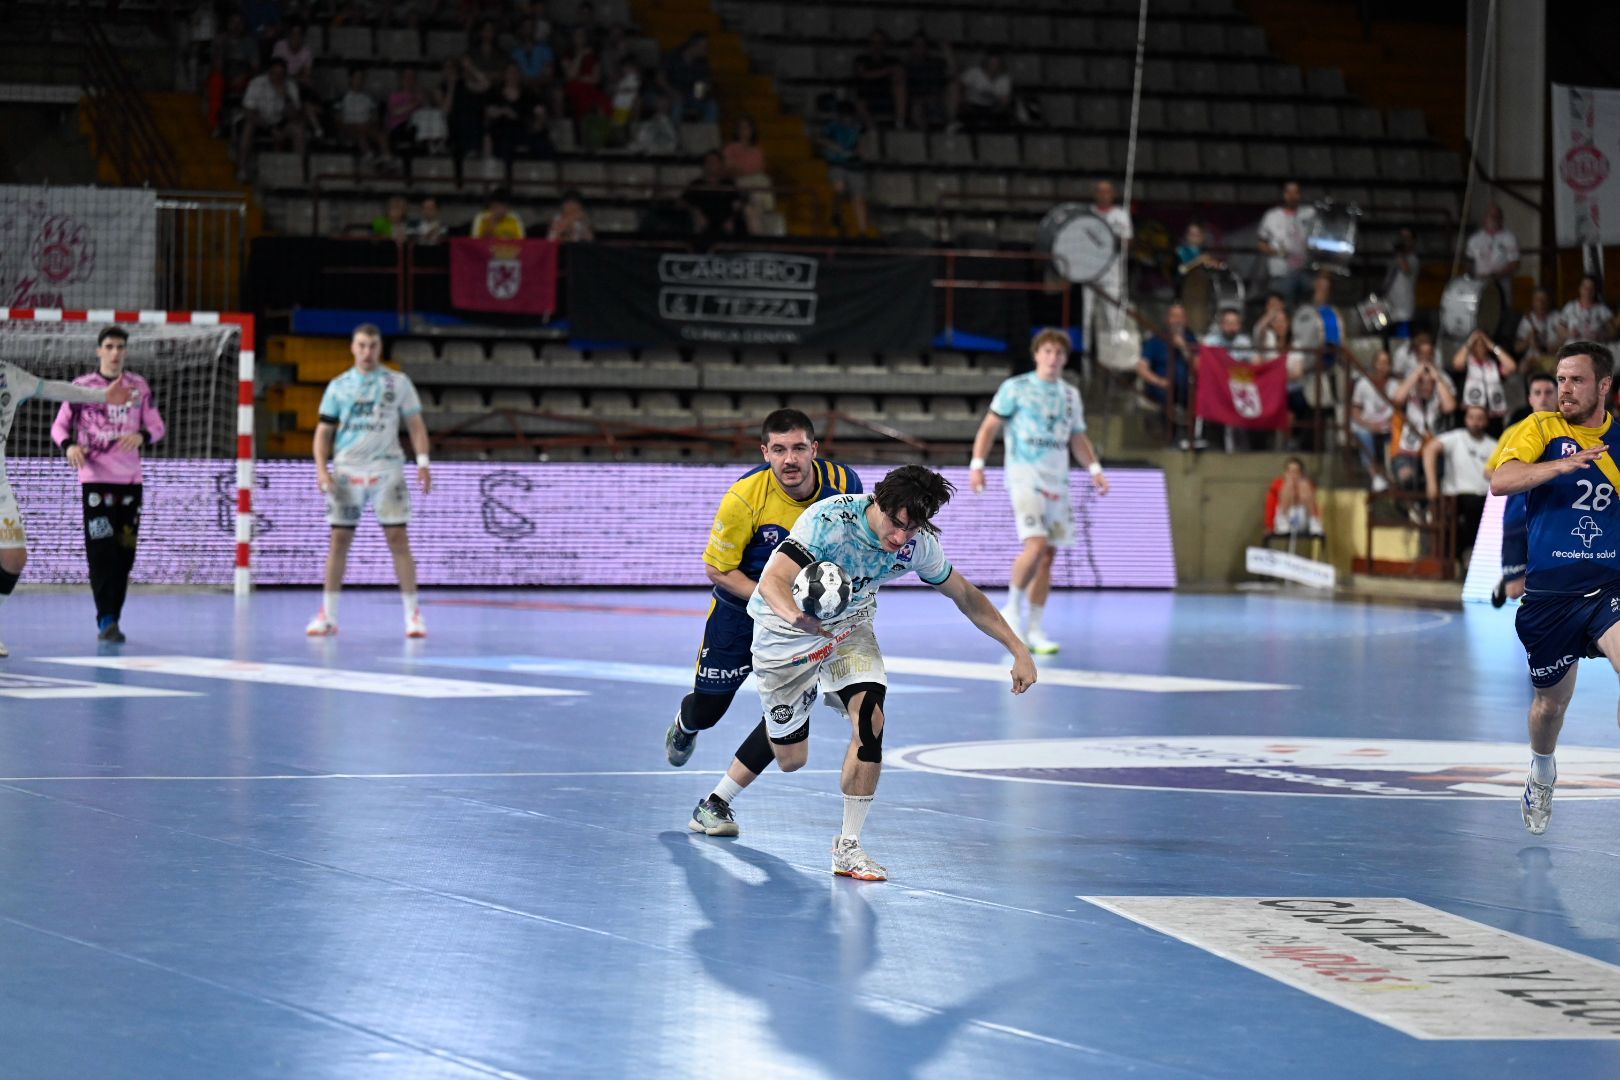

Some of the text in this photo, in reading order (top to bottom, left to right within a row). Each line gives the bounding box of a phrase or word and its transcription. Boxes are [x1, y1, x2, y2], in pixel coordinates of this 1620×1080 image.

[671, 258, 803, 282] CARRERO
[715, 297, 801, 318] TEZZA
[1571, 479, 1614, 512] 28
[1551, 549, 1616, 559] recoletas salud
[1257, 899, 1510, 964] CASTILLA
[1428, 969, 1575, 983] Y
